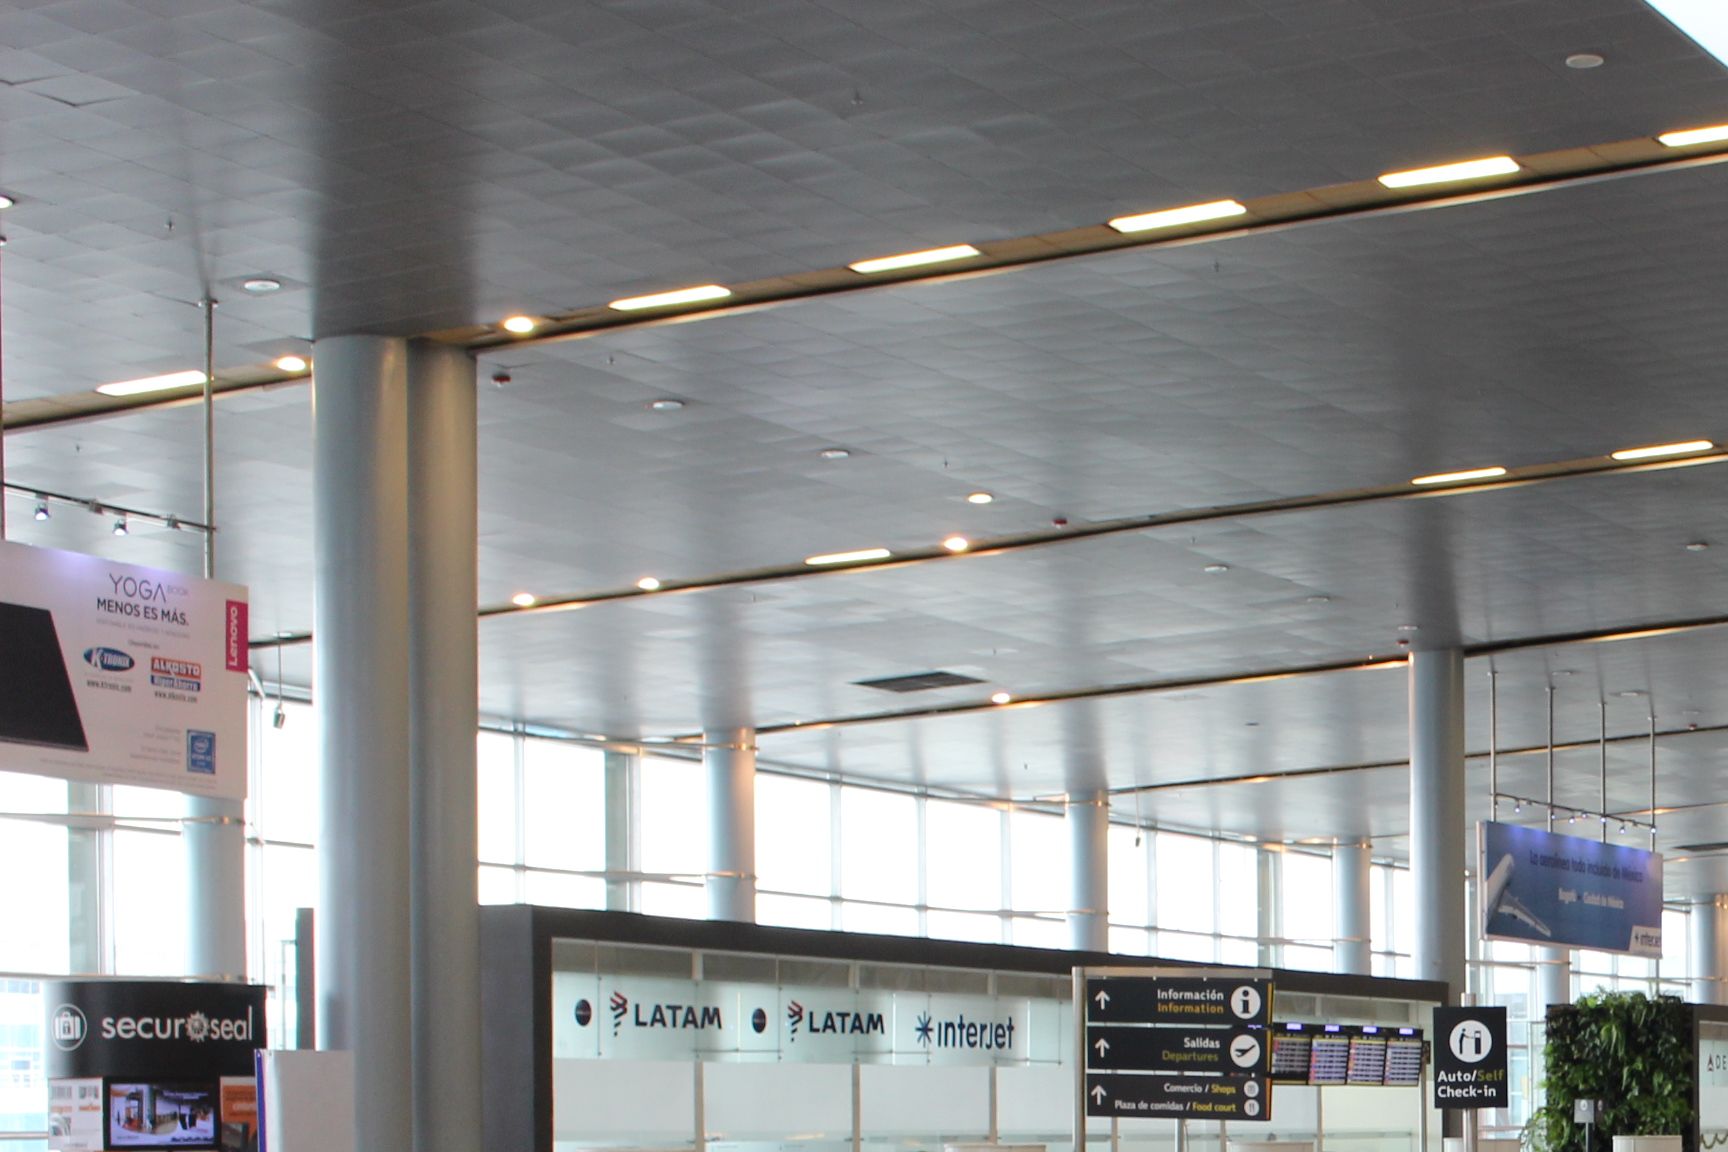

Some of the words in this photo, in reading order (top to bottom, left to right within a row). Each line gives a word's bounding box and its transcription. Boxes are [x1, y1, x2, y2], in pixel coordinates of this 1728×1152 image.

[108, 573, 167, 603] YOGA
[96, 597, 141, 617] MENOS
[143, 606, 158, 620] ES
[161, 608, 189, 626] MÁS.
[229, 606, 238, 666] Lenovo
[153, 658, 200, 677] ALKOSTO
[1157, 989, 1224, 1001] Información
[1157, 1003, 1224, 1013] Information
[634, 1004, 722, 1030] LATAM
[809, 1011, 885, 1035] LATAM
[937, 1014, 1015, 1050] interjet
[1183, 1037, 1220, 1049] Salidas
[1162, 1051, 1219, 1063] Departures
[1163, 1083, 1202, 1094] Comercio
[1211, 1084, 1236, 1095] Shops
[1437, 1084, 1497, 1098] Check-in
[1114, 1101, 1135, 1111] Plaza
[1138, 1101, 1148, 1110] de
[1150, 1101, 1184, 1111] comidas
[1192, 1101, 1212, 1112] Food
[1214, 1103, 1236, 1112] court
